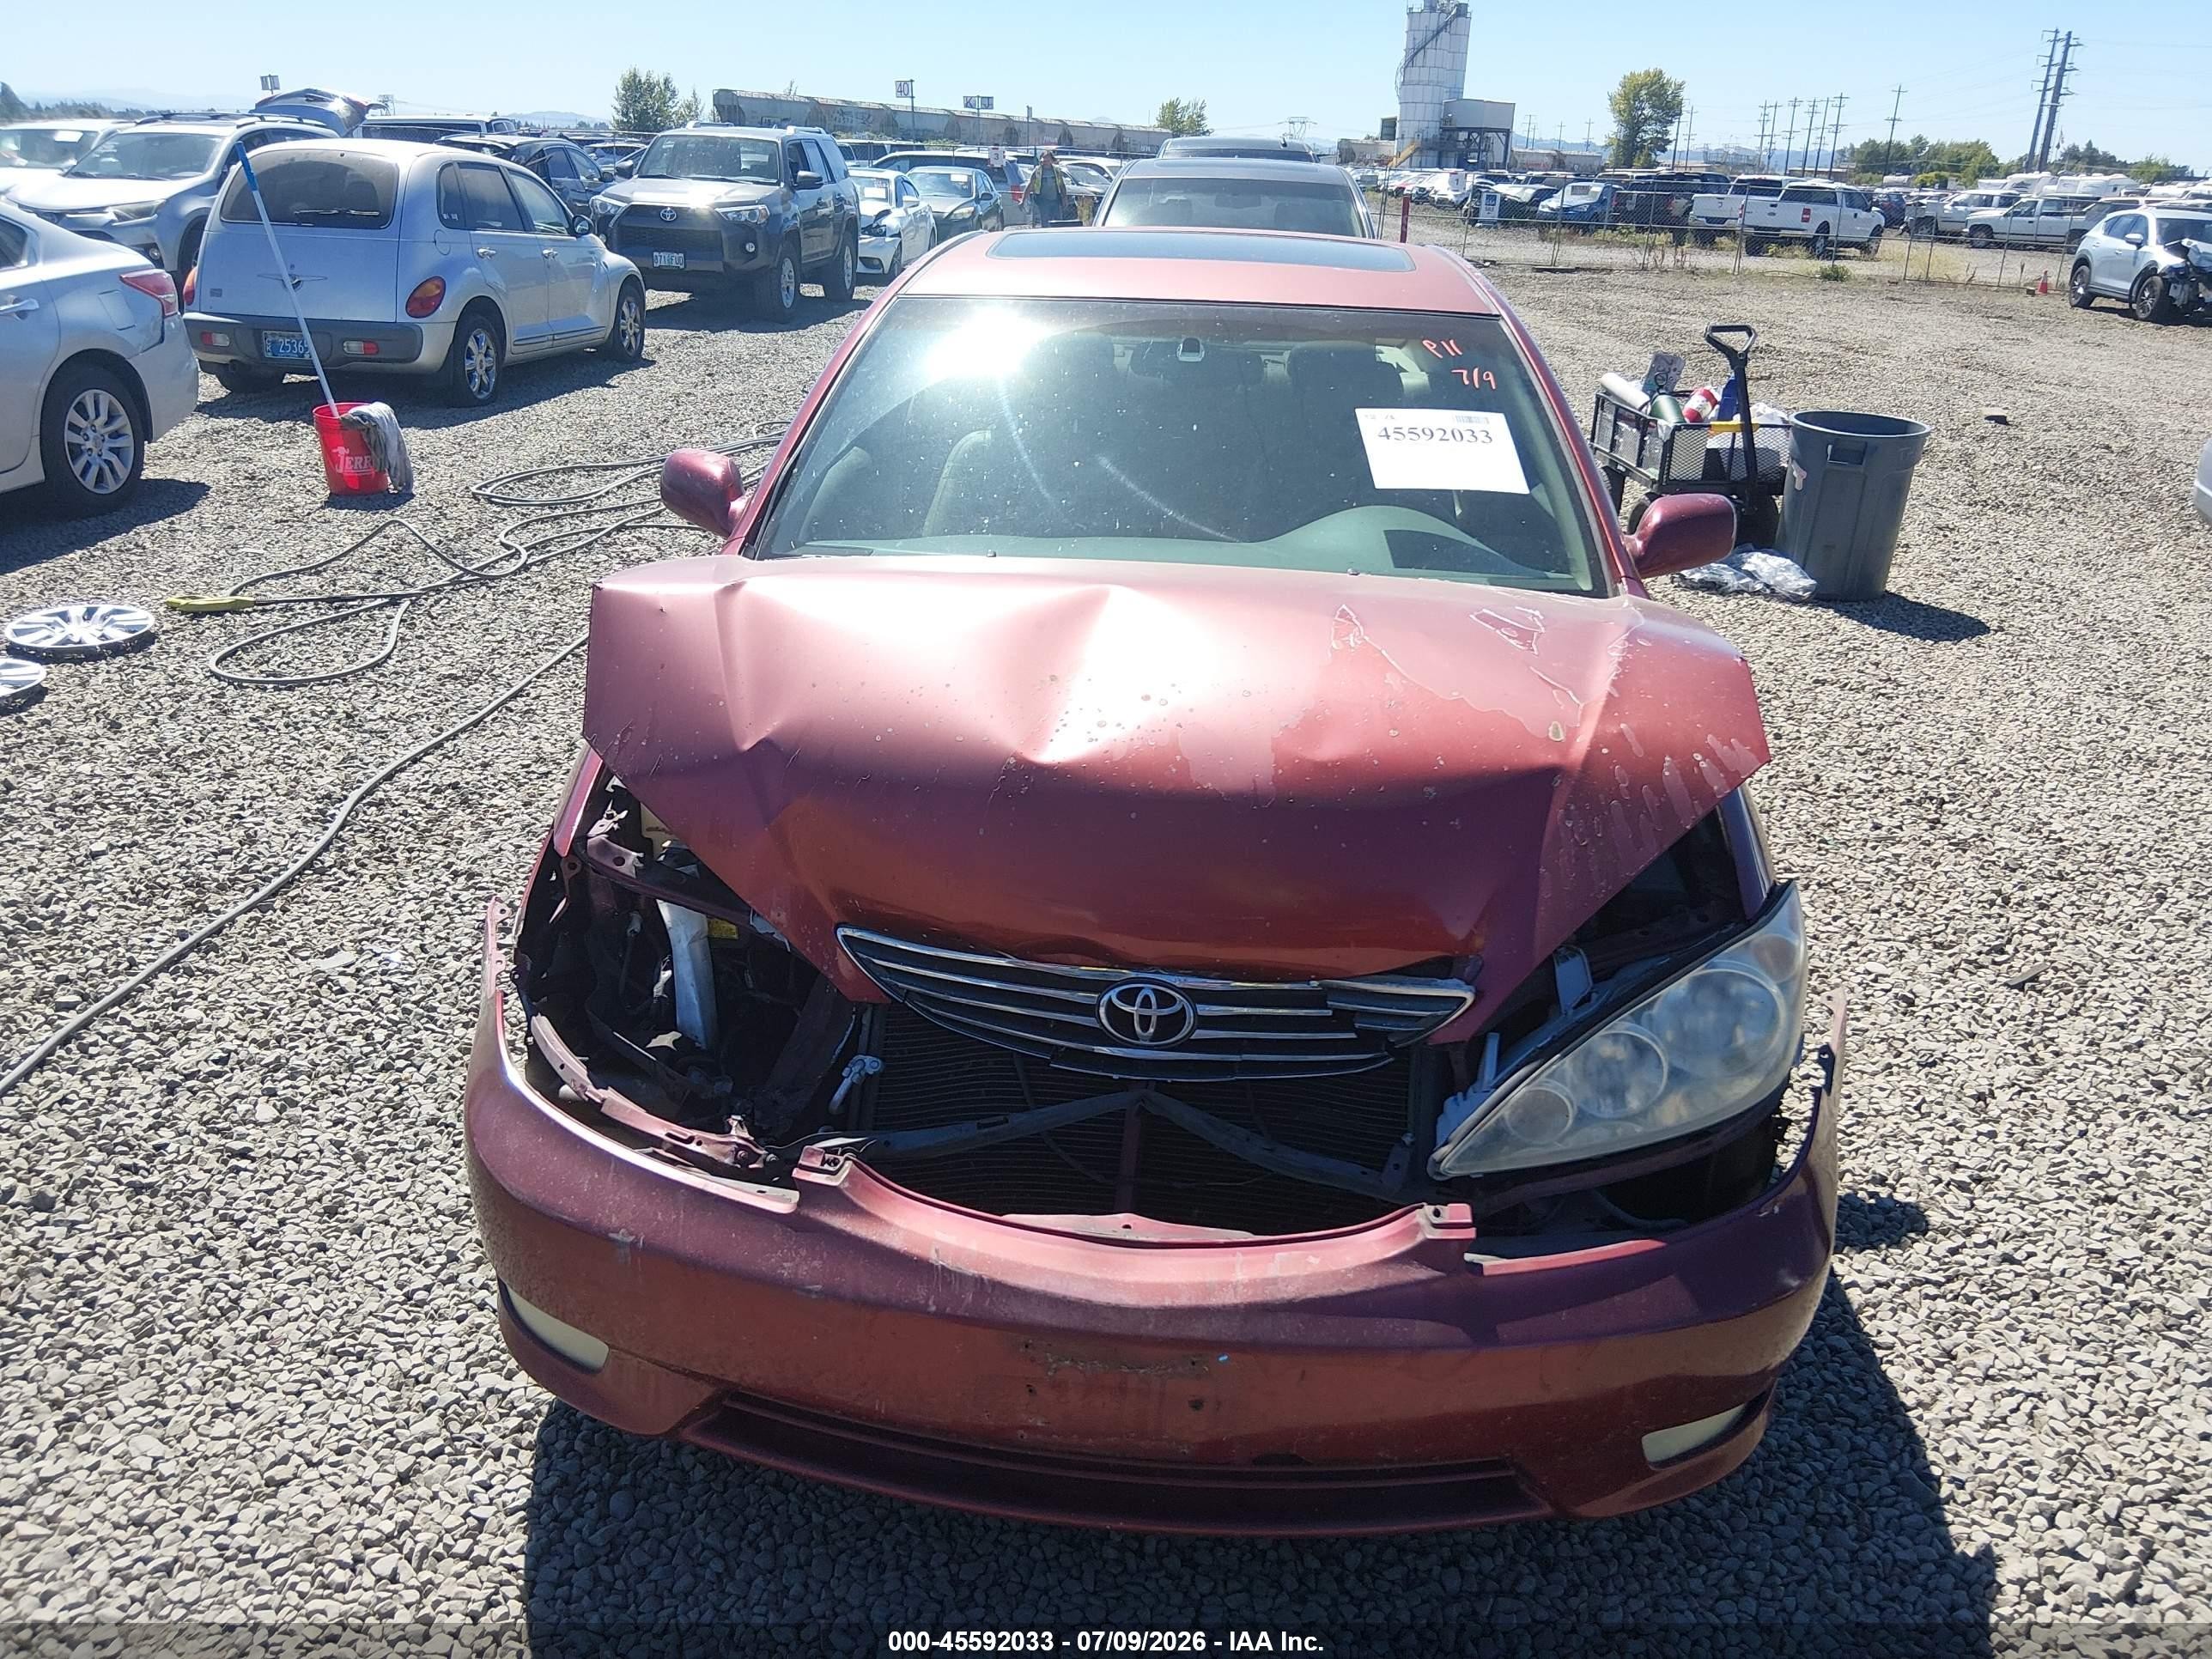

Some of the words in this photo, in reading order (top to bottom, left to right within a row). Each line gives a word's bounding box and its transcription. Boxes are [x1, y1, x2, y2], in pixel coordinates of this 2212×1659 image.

[896, 82, 909, 96] 40
[965, 97, 974, 108] K
[982, 98, 990, 108] J
[1451, 368, 1496, 389] 7/9
[1377, 427, 1492, 444] 45592033
[335, 453, 372, 473] JERR
